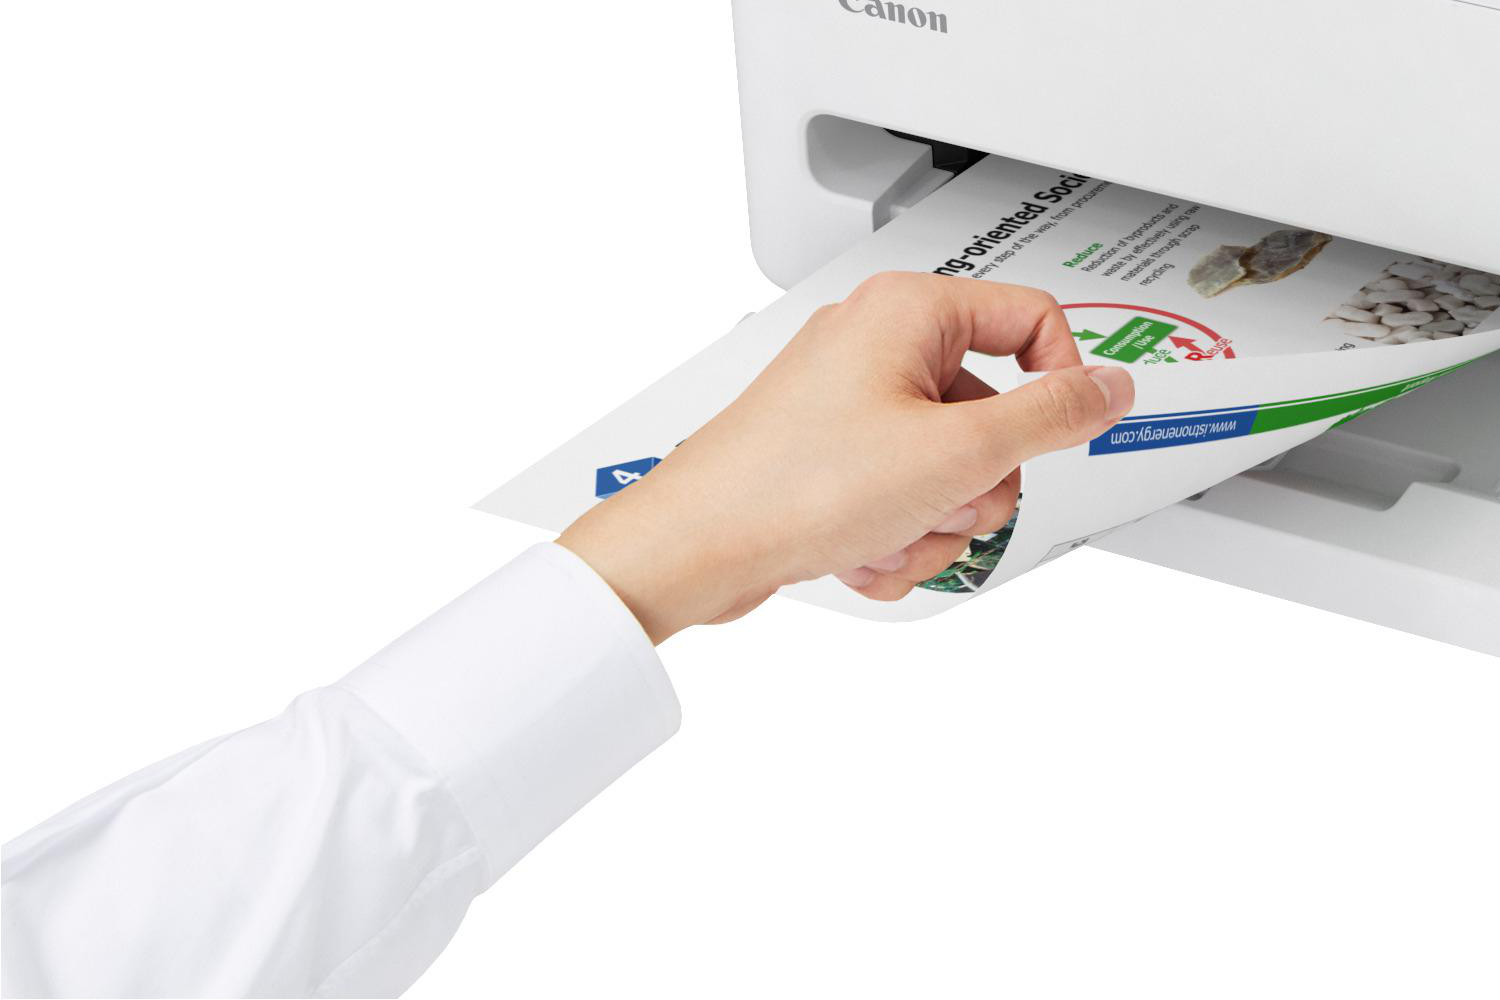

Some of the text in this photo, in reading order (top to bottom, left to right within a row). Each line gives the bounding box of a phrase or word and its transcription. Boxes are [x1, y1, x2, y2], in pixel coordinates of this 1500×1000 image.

[971, 262, 999, 279] every
[994, 248, 1017, 264] step
[1012, 241, 1025, 252] of
[1020, 232, 1039, 245] the
[1050, 207, 1076, 222] from
[1061, 242, 1104, 269] Reduce
[1081, 203, 1180, 272] Reduction of byproducts and
[1101, 204, 1201, 277] waste by effectively using raw
[1120, 223, 1201, 281] materials through scrap
[1139, 263, 1176, 286] recycling
[1103, 320, 1154, 356] Consumption
[1184, 338, 1233, 361] Reuse
[611, 468, 643, 485] 4
